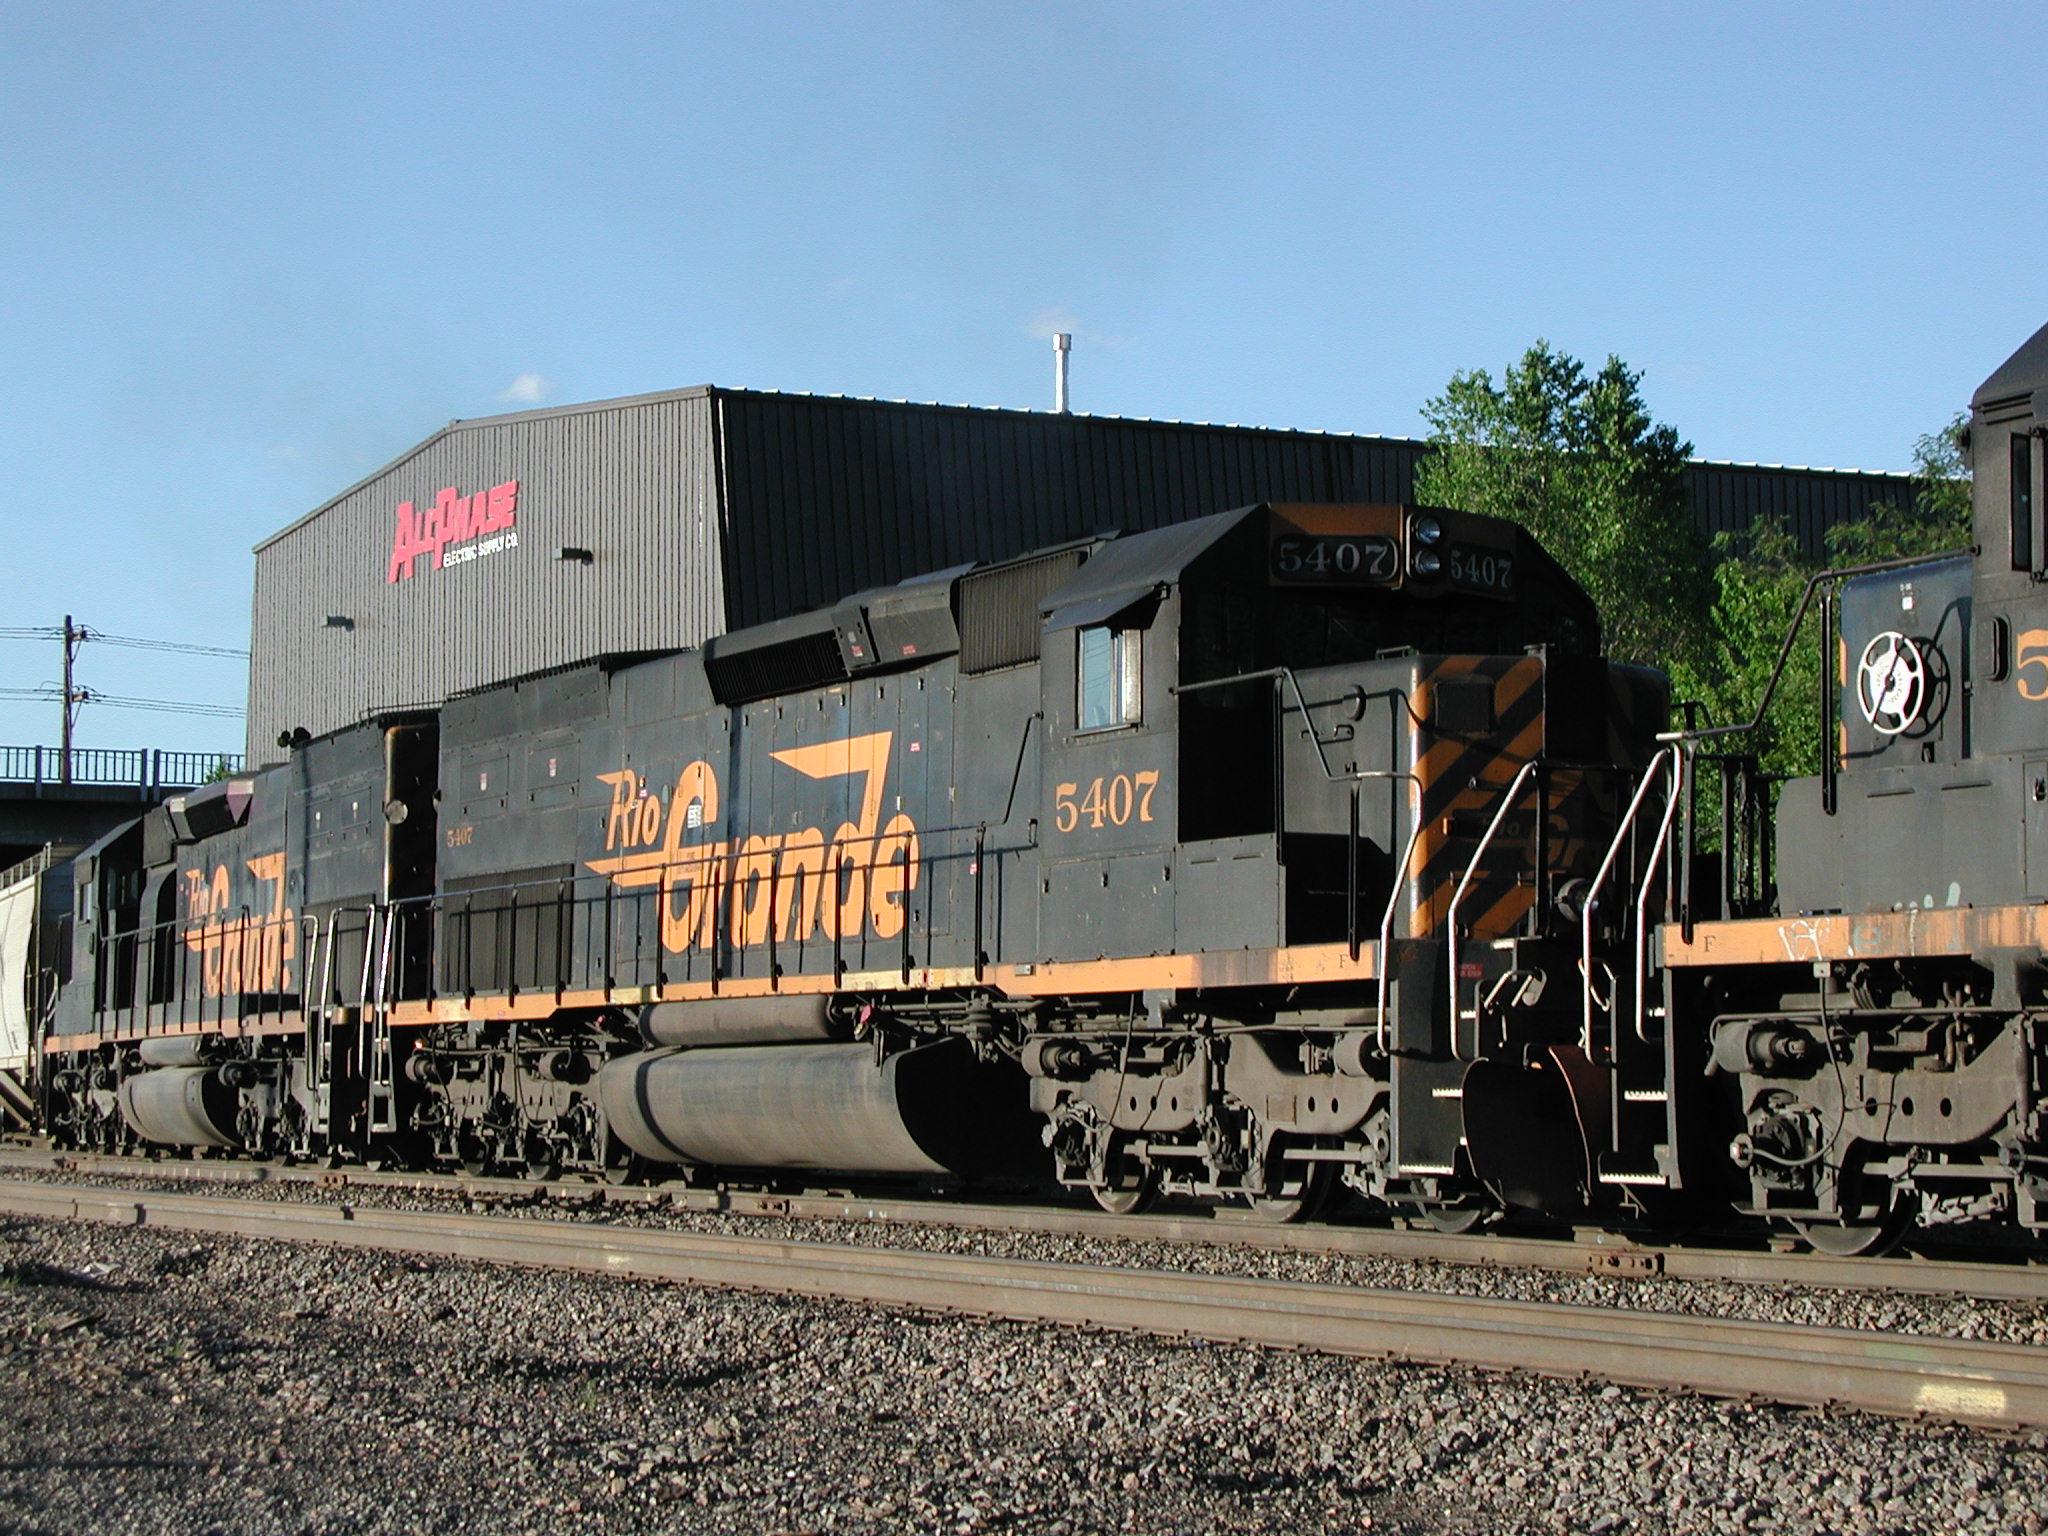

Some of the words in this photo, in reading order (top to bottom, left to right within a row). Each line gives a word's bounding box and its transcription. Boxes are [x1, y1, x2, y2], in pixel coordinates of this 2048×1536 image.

[1278, 546, 1390, 575] 5407
[1450, 547, 1512, 589] 5407
[596, 769, 660, 850] Rio
[1055, 769, 1160, 832] 5407
[447, 826, 473, 848] 5407
[584, 731, 920, 953] Grande
[1704, 935, 1716, 952] F
